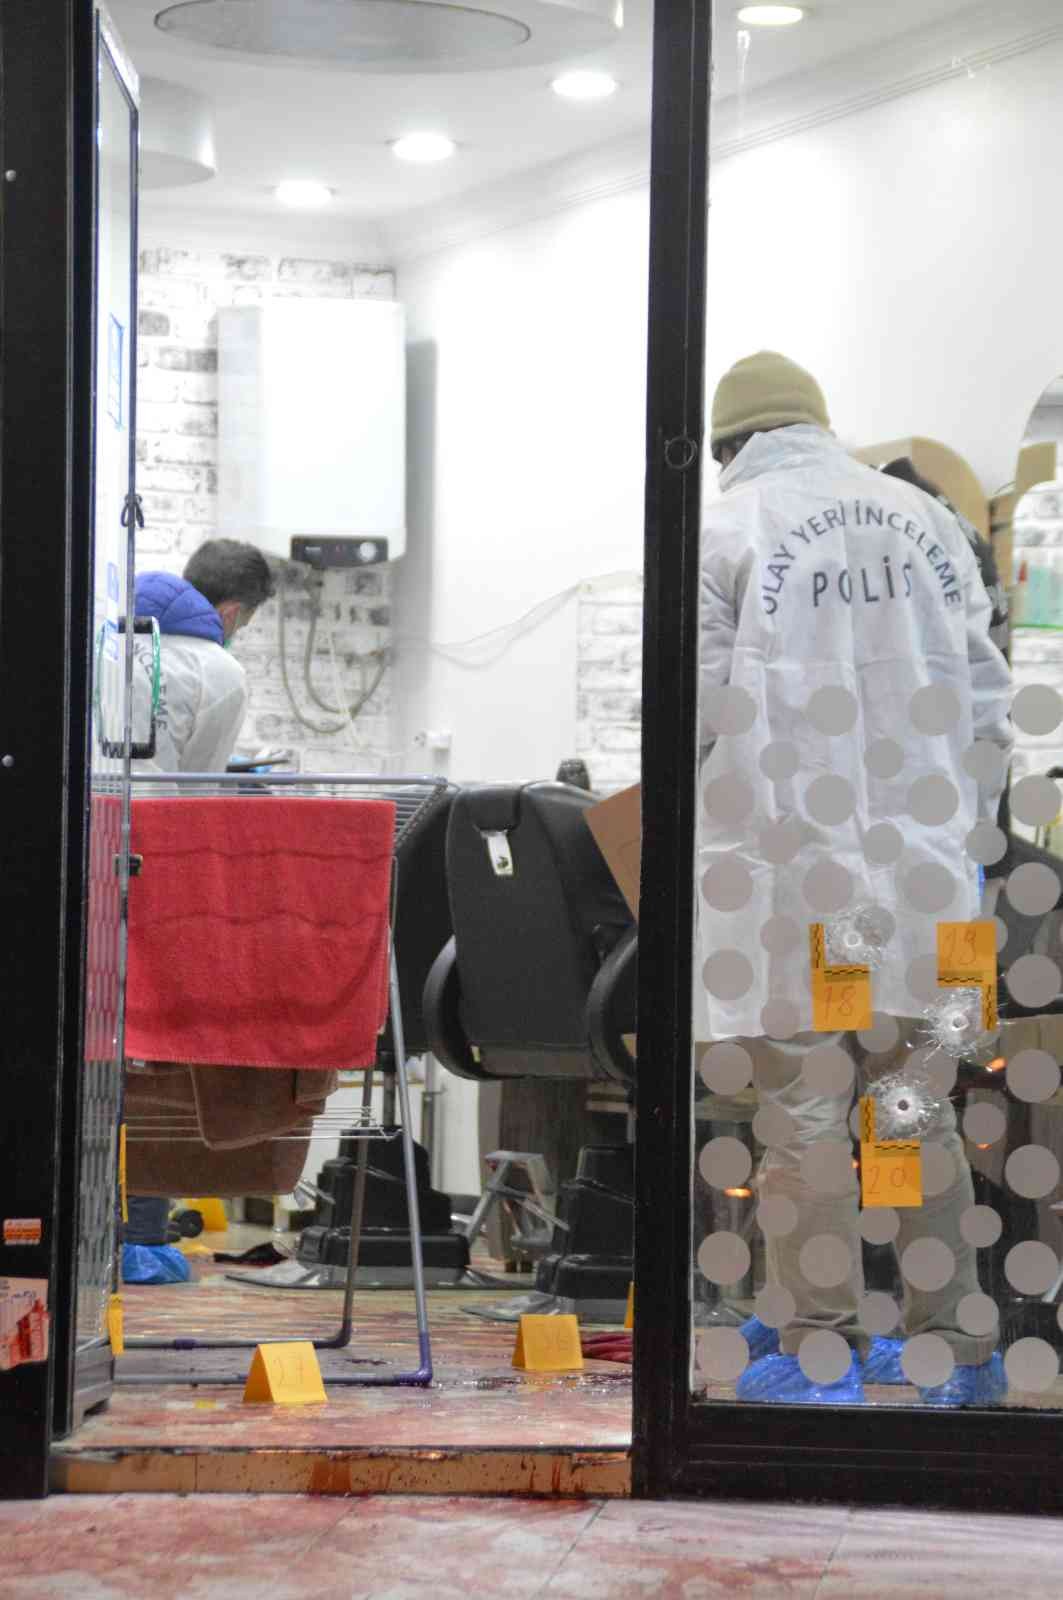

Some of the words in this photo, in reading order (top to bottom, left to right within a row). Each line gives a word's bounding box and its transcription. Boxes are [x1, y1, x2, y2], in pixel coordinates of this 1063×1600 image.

[855, 499, 961, 607] İNCELEME
[812, 555, 913, 607] POLİS
[868, 1164, 907, 1195] 20
